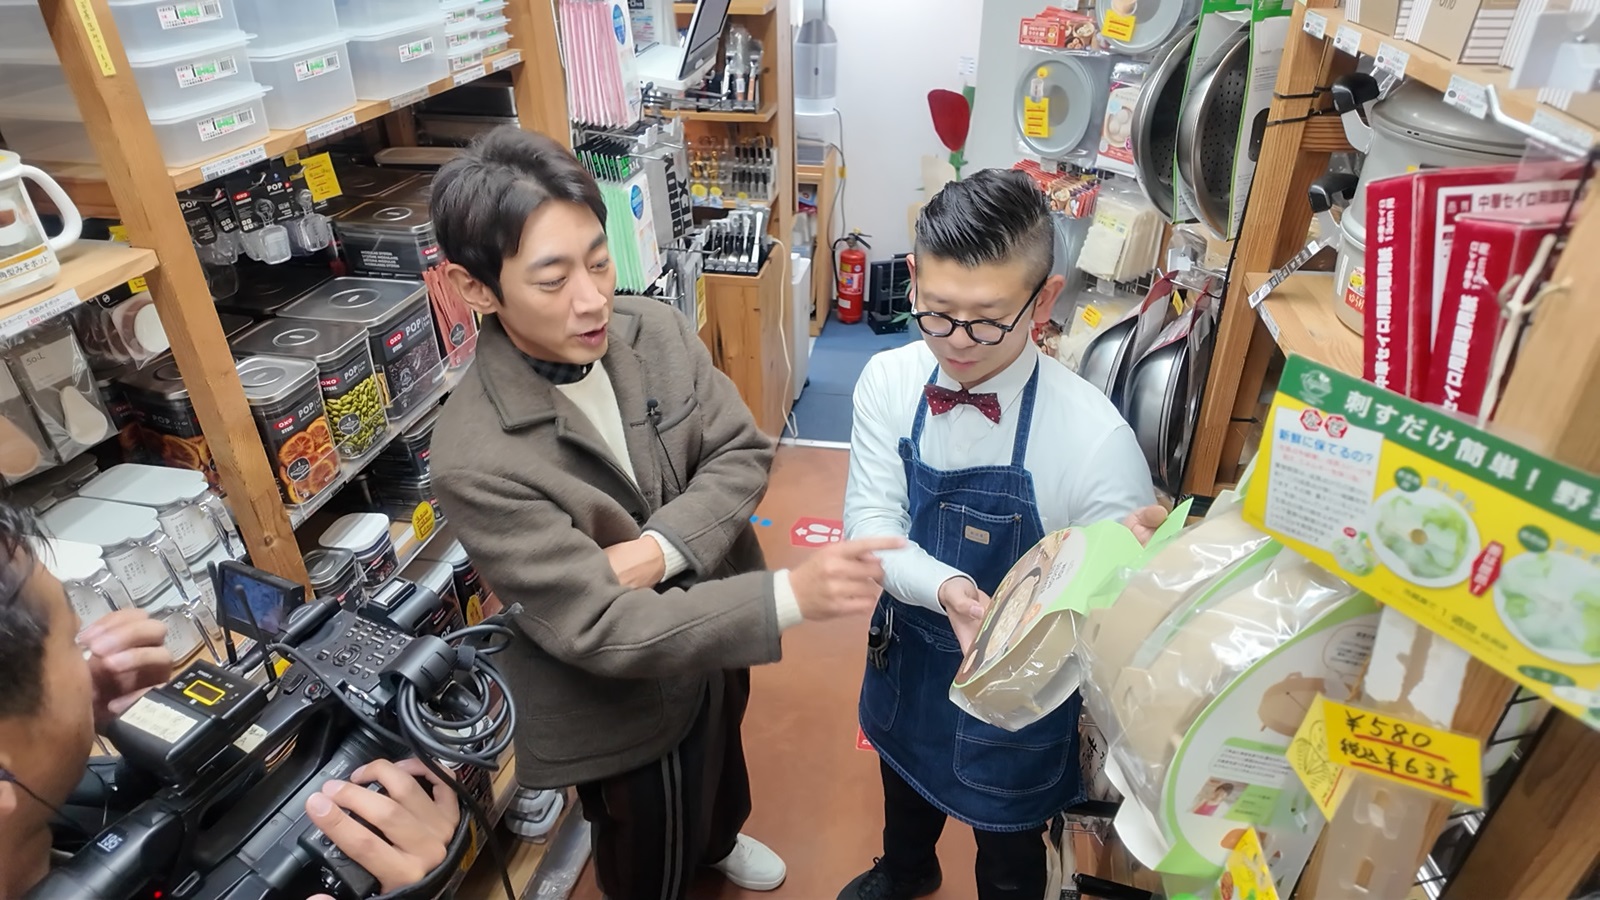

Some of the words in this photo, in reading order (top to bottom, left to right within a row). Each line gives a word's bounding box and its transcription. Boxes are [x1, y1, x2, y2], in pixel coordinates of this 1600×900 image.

[267, 182, 283, 192] POP
[677, 178, 693, 235] TEX
[405, 318, 421, 336] POP
[389, 333, 402, 345] OXO
[344, 365, 358, 380] POP
[298, 402, 314, 418] POP
[278, 418, 293, 428] OXO
[1345, 709, 1431, 748] ¥580
[101, 832, 123, 851] 195
